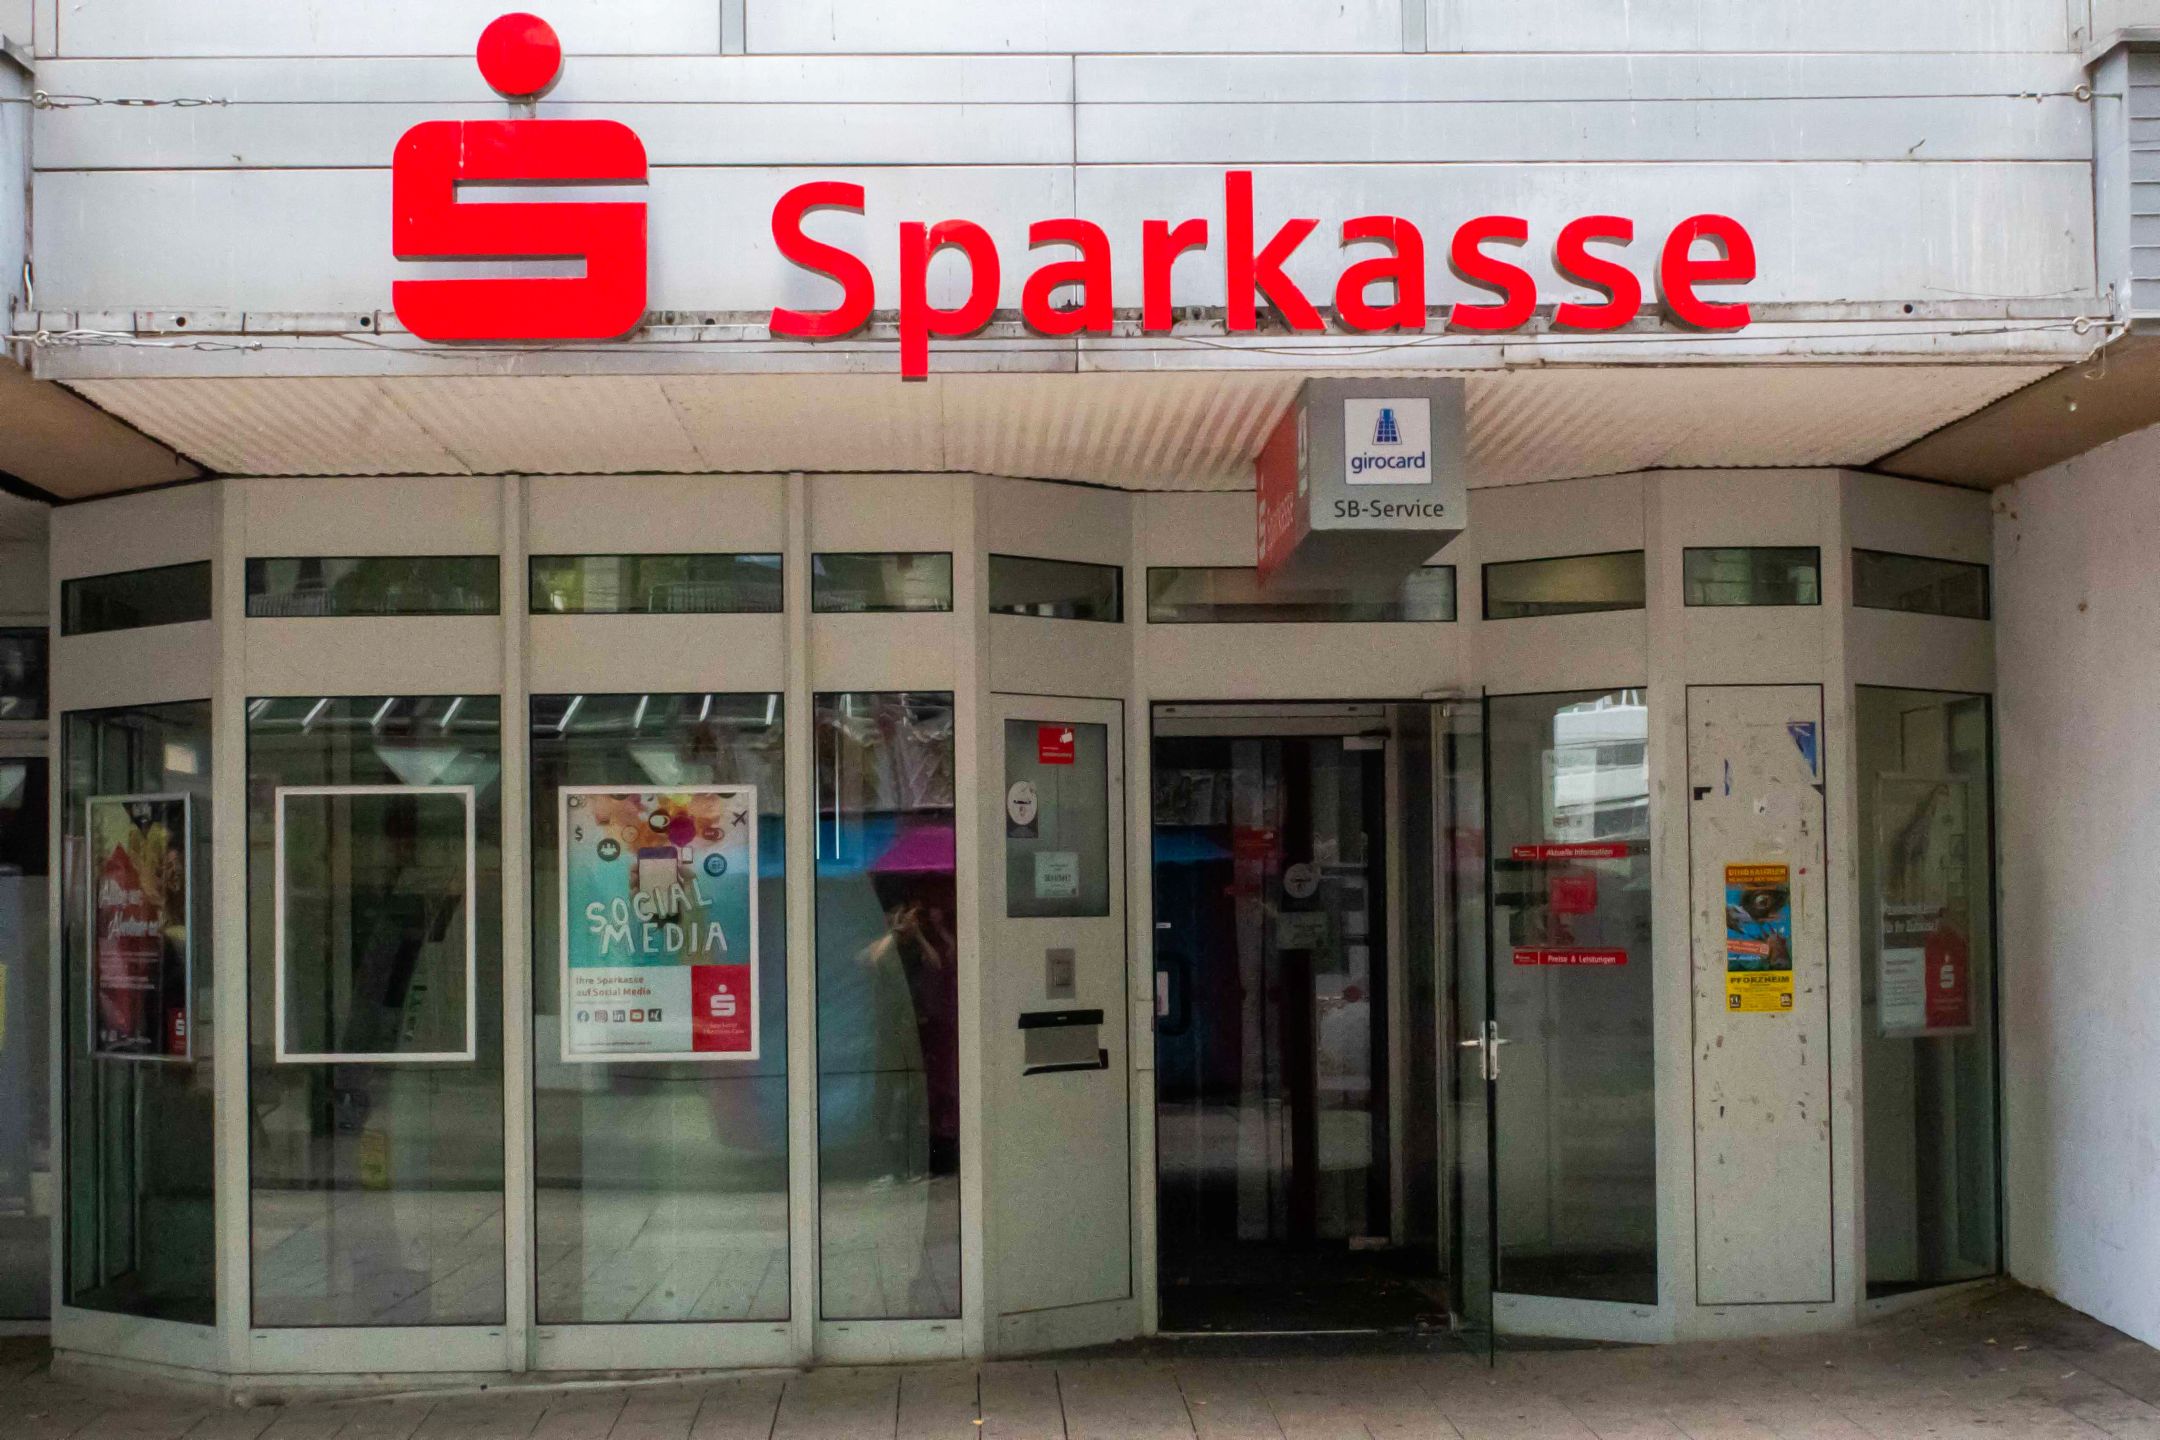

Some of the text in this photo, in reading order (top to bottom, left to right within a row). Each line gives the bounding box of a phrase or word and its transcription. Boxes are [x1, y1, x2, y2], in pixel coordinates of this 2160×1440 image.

[769, 170, 1757, 380] Sparkasse
[1351, 451, 1426, 474] girocard
[1333, 499, 1445, 518] SB-Service
[585, 878, 713, 933] SOCIAL
[602, 921, 728, 955] MEDIA
[576, 976, 594, 985] Ihre
[592, 987, 621, 997] Social
[623, 986, 652, 997] Media
